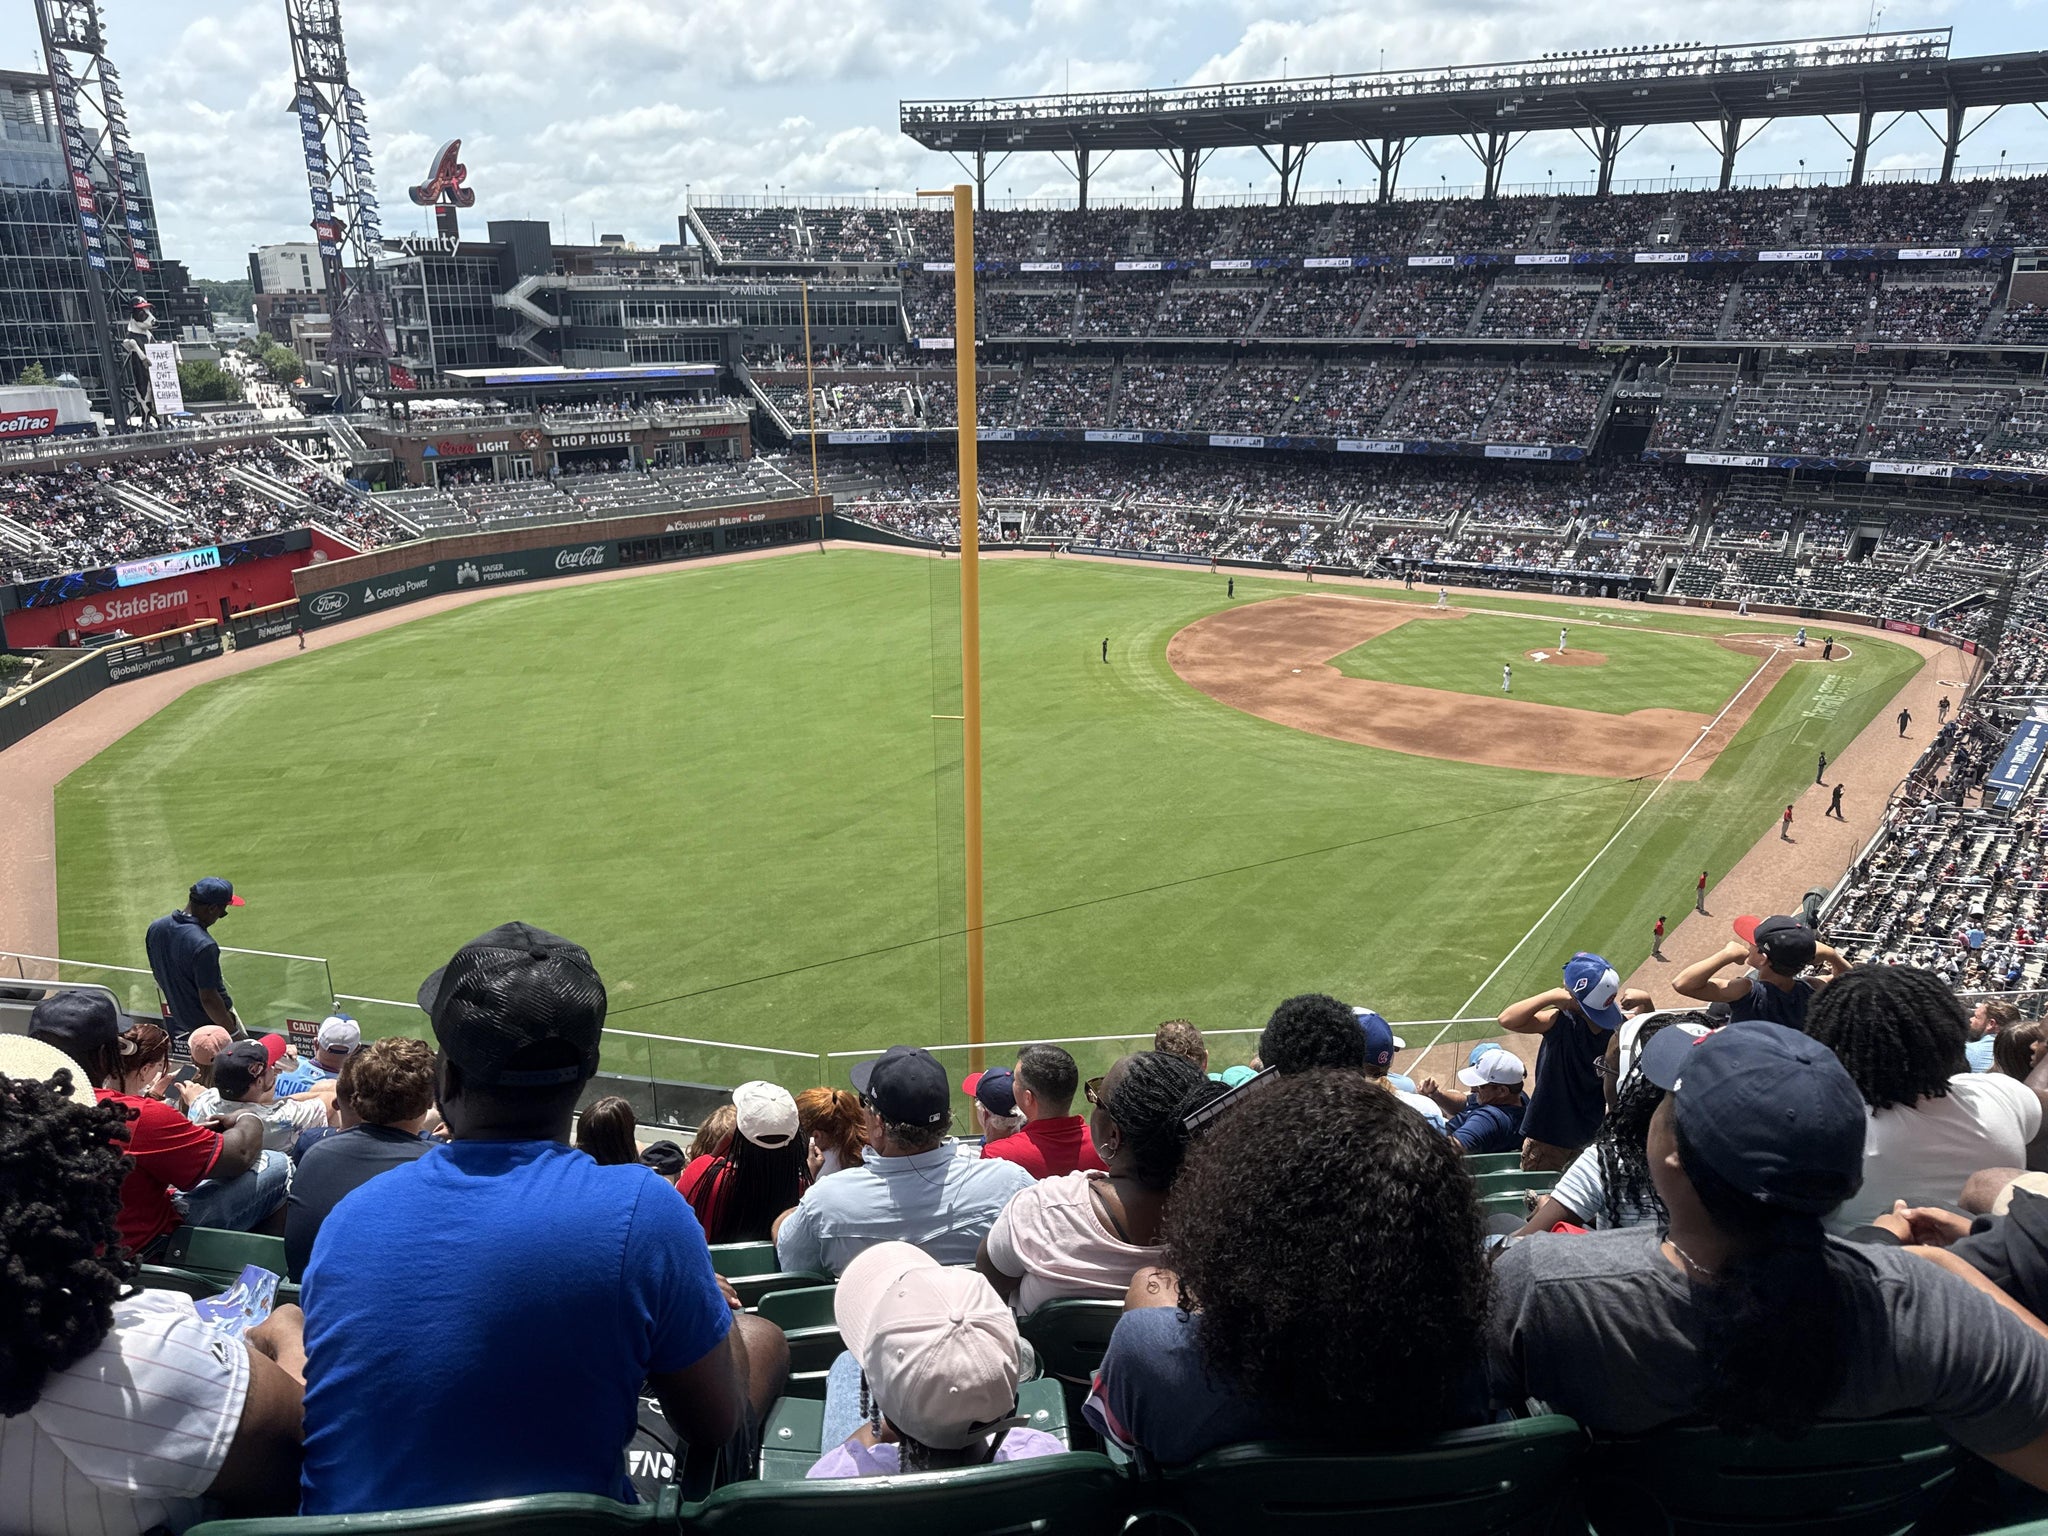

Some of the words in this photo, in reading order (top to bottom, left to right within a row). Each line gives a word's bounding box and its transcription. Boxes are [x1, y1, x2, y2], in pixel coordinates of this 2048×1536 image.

[79, 197, 94, 208] 1957
[320, 227, 334, 238] 2021
[400, 230, 461, 257] xfinity
[90, 255, 105, 268] 1993
[740, 286, 778, 296] MILNER
[157, 361, 168, 370] ME
[670, 429, 690, 437] MADE
[690, 428, 701, 436] TO
[552, 434, 585, 448] CHOP
[591, 432, 632, 445] HOUSE
[476, 440, 510, 453] LIGHT
[697, 519, 716, 529] LIGHT
[193, 551, 216, 568] CAM
[482, 563, 504, 573] KAISER
[376, 585, 406, 600] Georgia
[406, 578, 429, 592] Power
[317, 595, 343, 612] Ford
